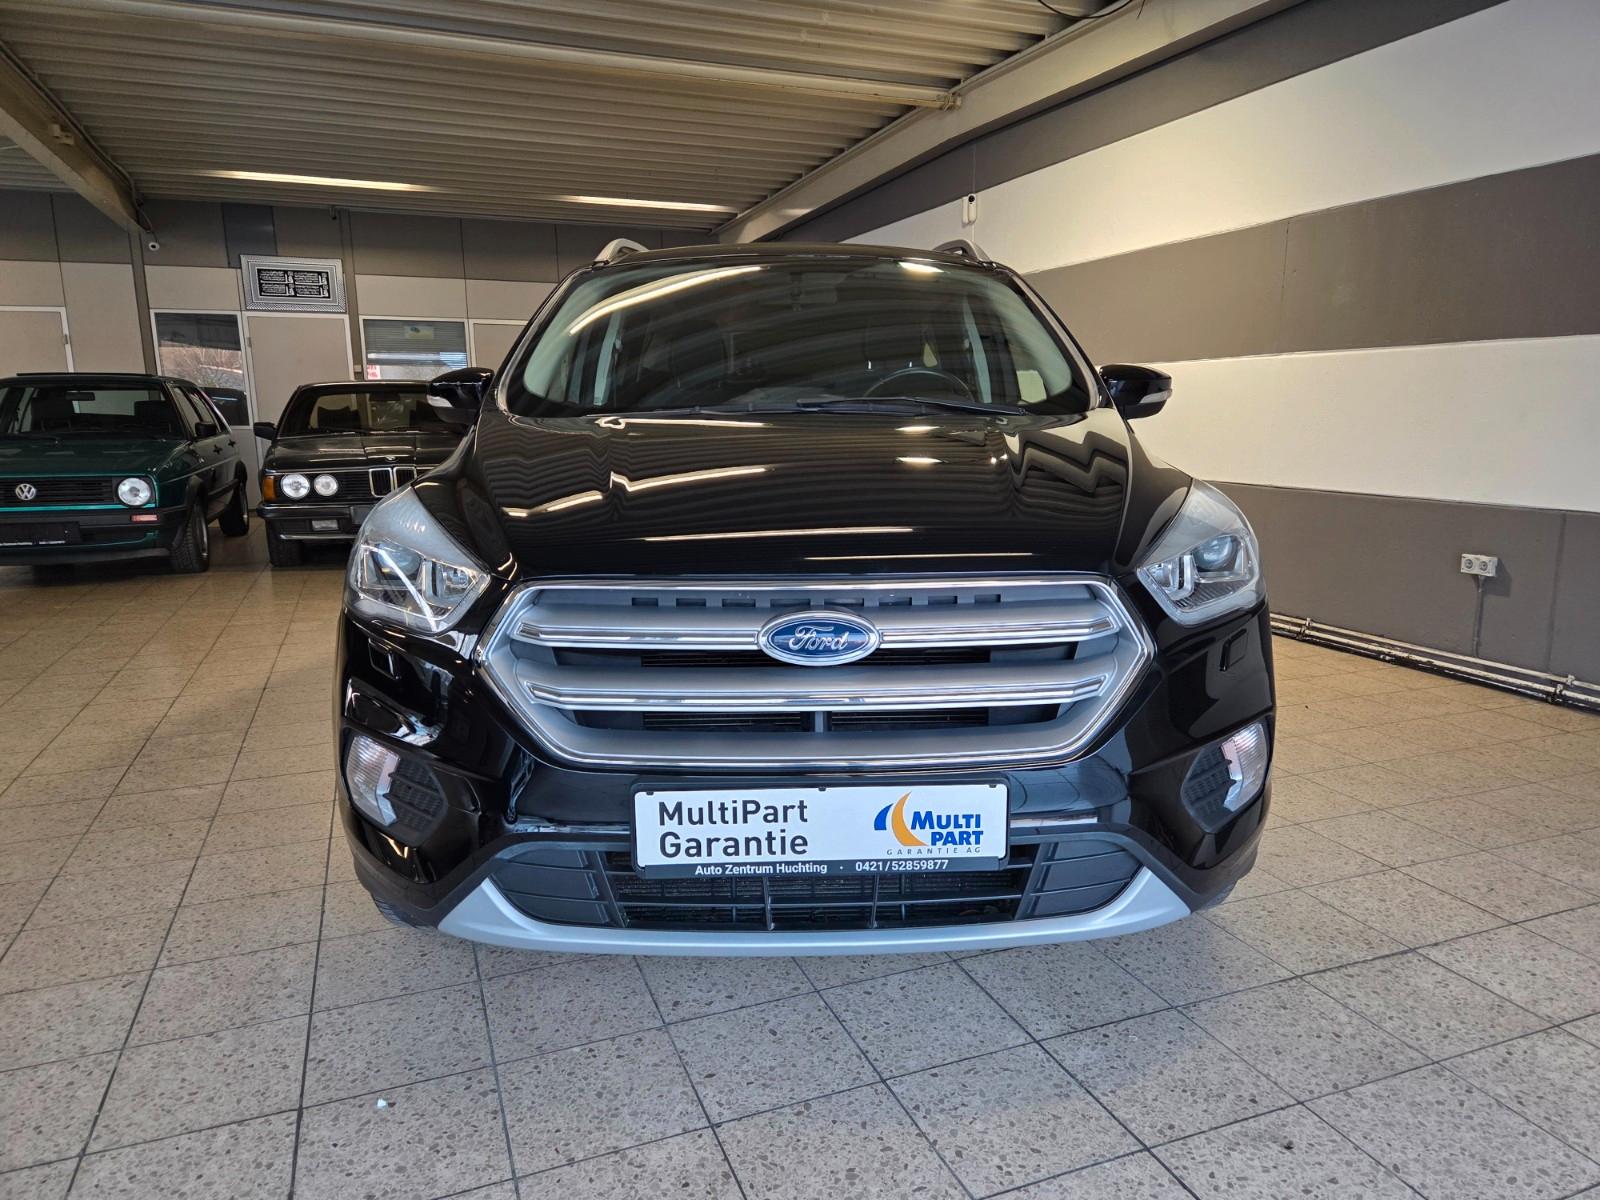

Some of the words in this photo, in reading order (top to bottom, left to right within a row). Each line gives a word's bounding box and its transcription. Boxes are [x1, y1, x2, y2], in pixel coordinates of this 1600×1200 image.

[788, 625, 849, 651] Ford
[658, 799, 808, 826] MultiPart
[910, 810, 982, 830] MULTI
[659, 829, 808, 858] Garantie
[930, 830, 984, 846] PART
[886, 847, 959, 856] GARANTIE
[966, 846, 981, 854] AG
[695, 864, 723, 876] Auto
[724, 864, 774, 875] Zentrum
[776, 862, 828, 875] Huchting
[855, 859, 949, 872] 0421/52859877
